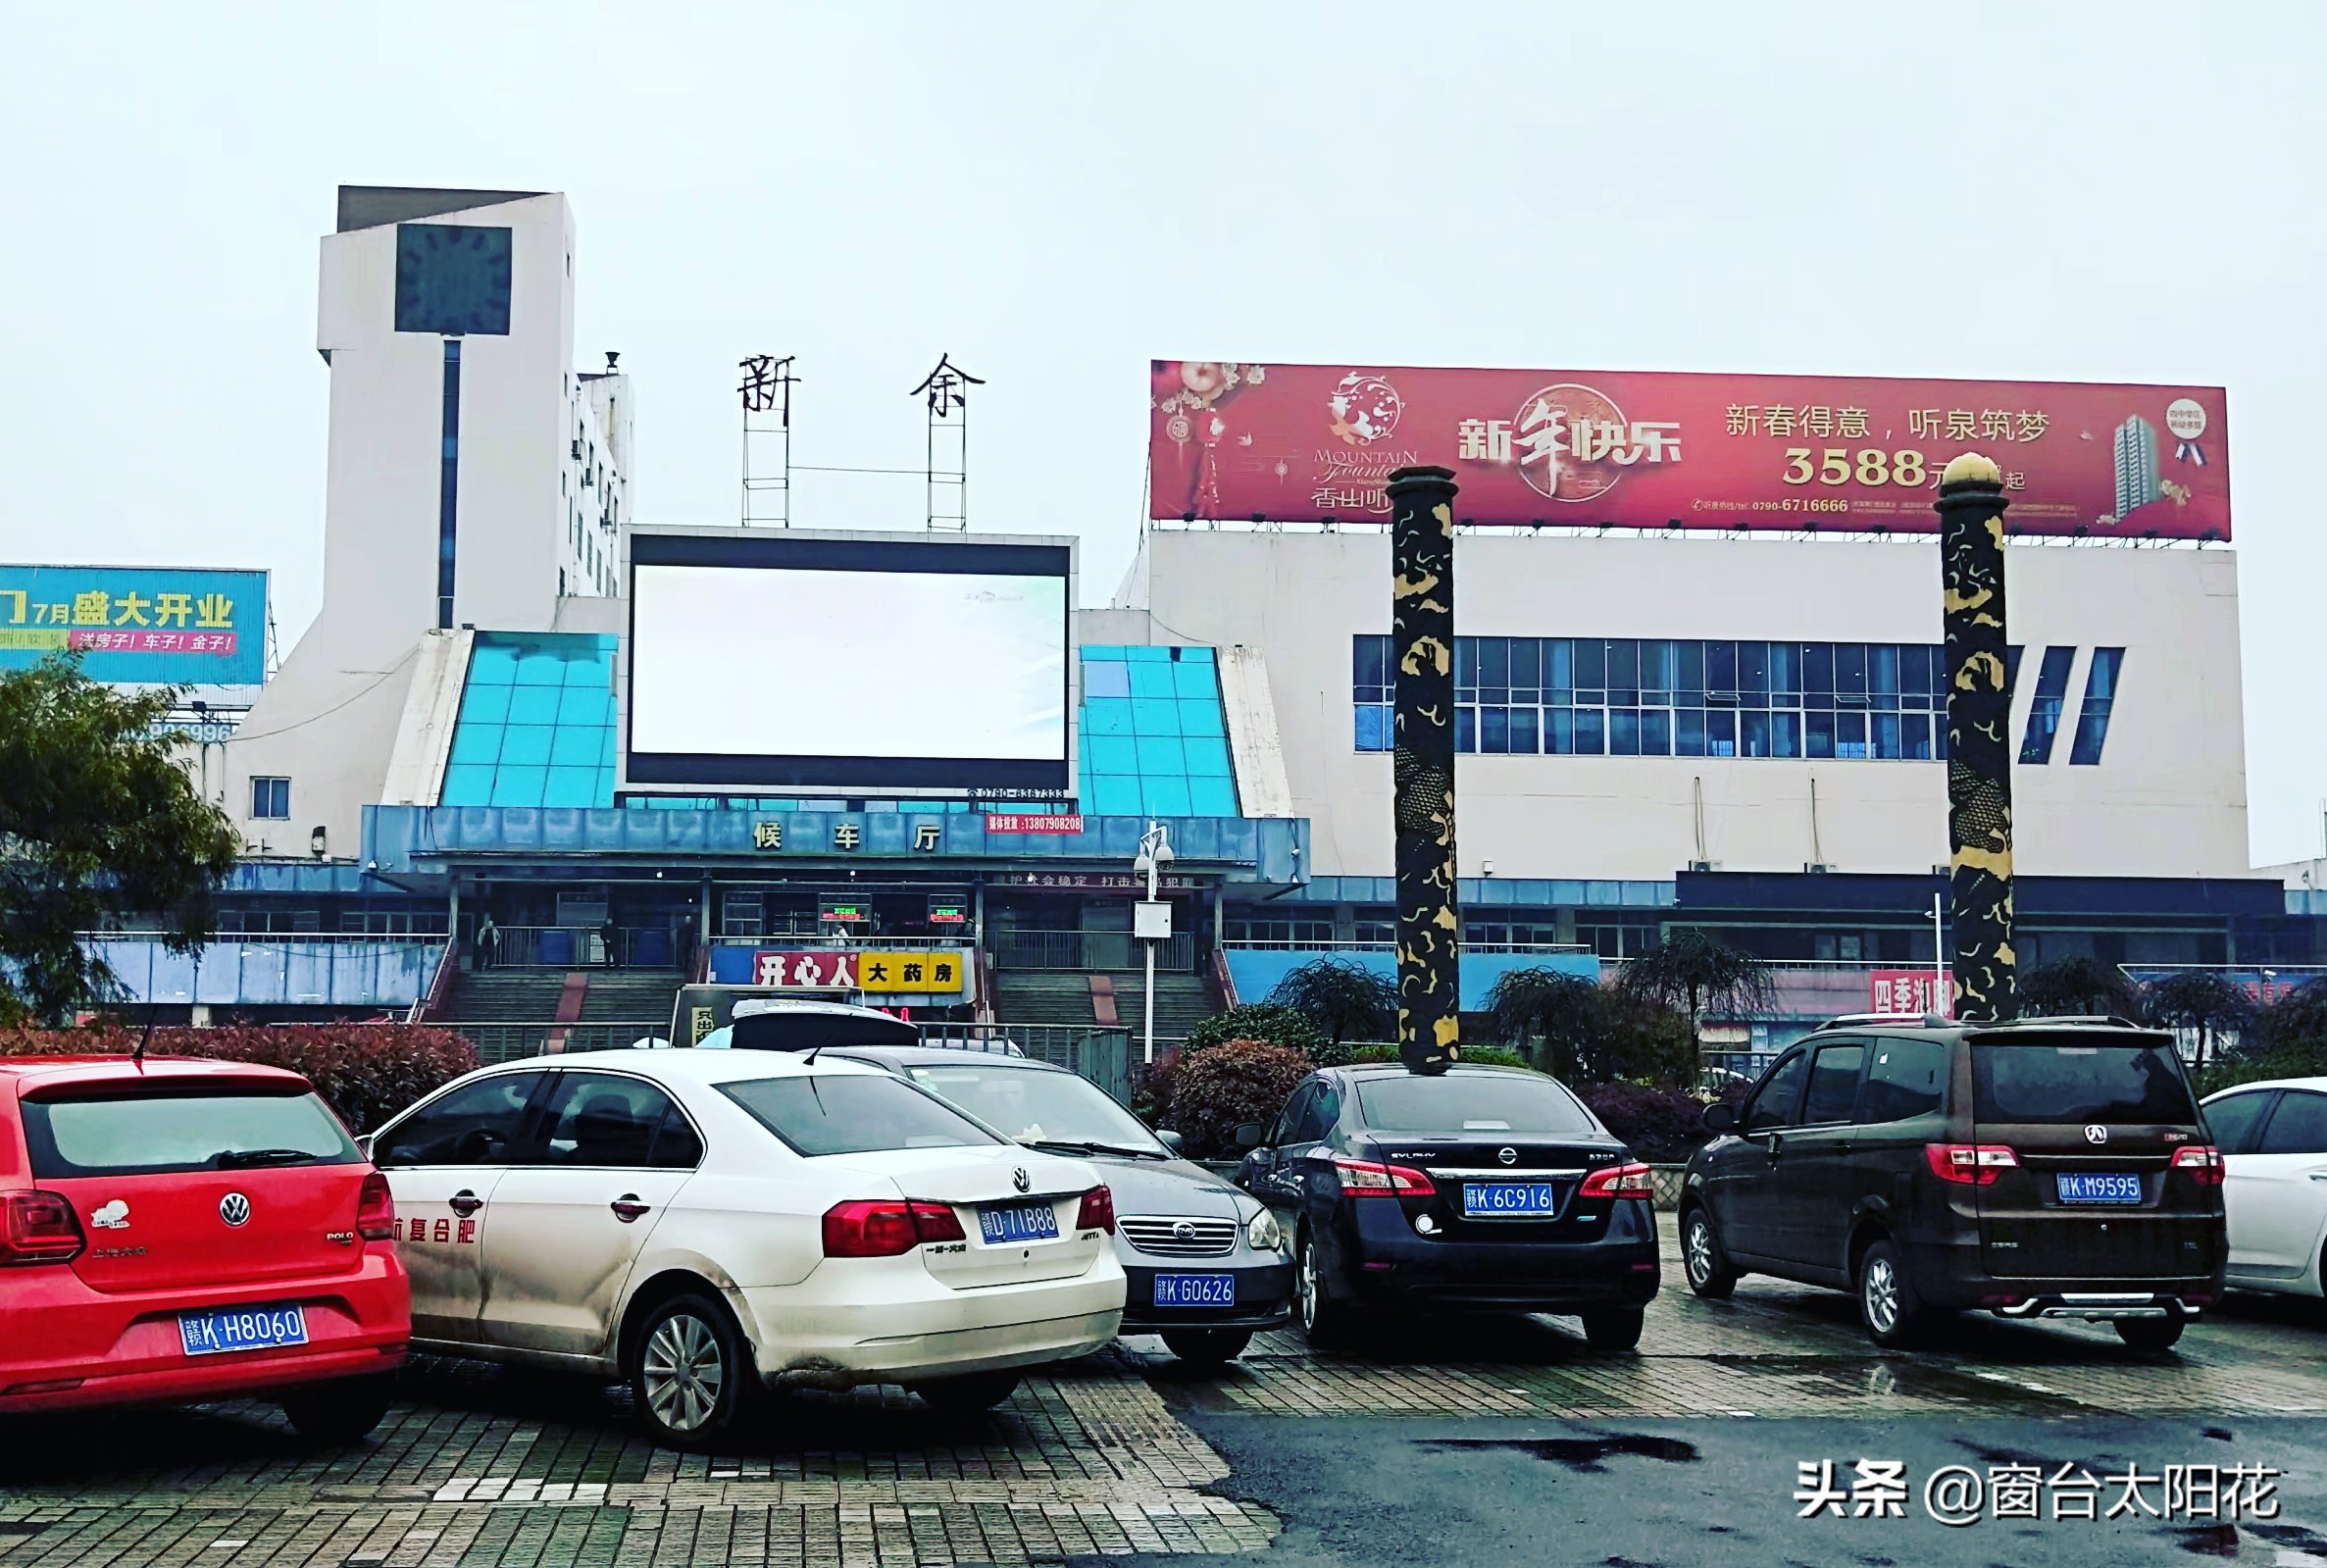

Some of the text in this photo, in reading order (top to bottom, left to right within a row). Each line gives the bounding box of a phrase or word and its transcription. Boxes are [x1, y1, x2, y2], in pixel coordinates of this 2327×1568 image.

[1314, 449, 1418, 464] MOUNTAIN
[1458, 398, 1682, 496] 新年快乐
[1311, 487, 1393, 513] 香山听
[1752, 498, 1848, 512] 0790-6716666
[753, 820, 941, 851] 候车厅
[759, 956, 952, 986] 开心人 大药房
[184, 1310, 301, 1346] 赣K·H8060
